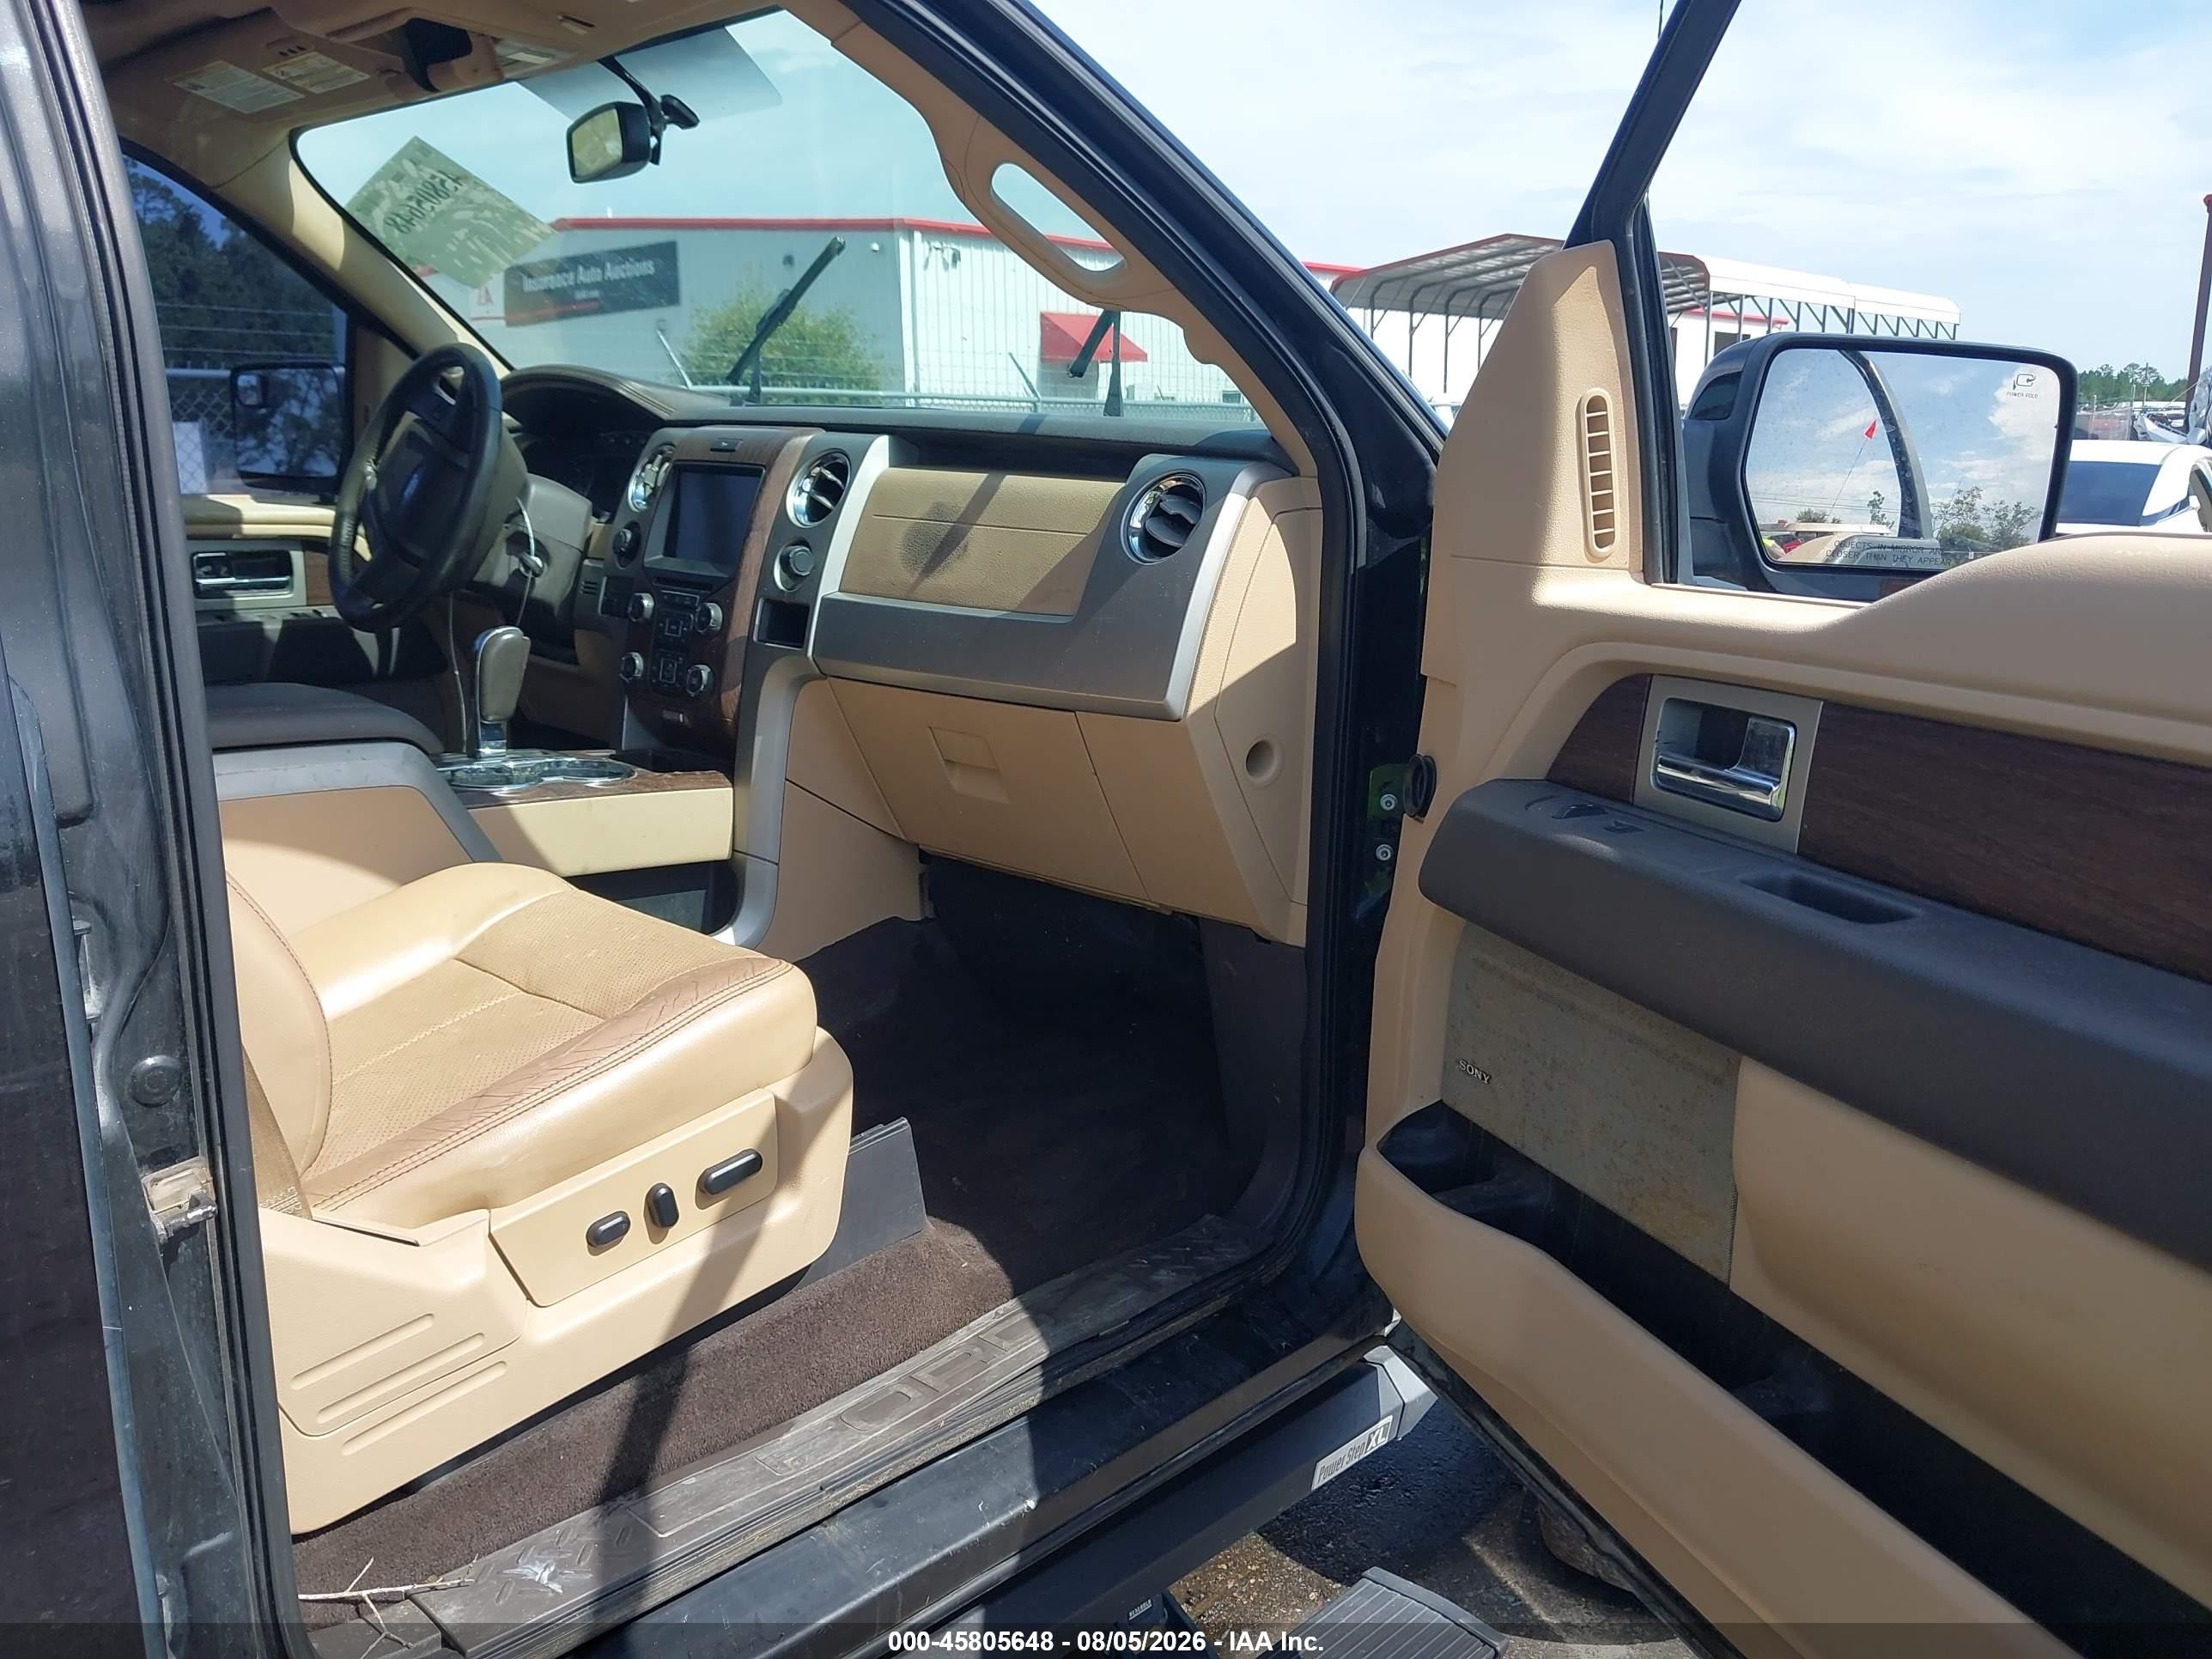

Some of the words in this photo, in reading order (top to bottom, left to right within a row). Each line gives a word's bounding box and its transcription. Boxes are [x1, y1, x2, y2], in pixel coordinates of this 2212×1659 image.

[522, 271, 575, 292] Insurance
[576, 264, 602, 284] Auto
[604, 259, 655, 281] Auctions
[1826, 550, 1860, 559] CLOSER
[1866, 552, 1887, 561] THAN
[1893, 554, 1914, 563] THEY
[1917, 556, 1952, 567] APPEAR
[1833, 540, 1872, 550] OBJECTS
[1891, 544, 1924, 554] MIRROR
[1459, 1059, 1492, 1085] SONY
[1317, 1454, 1346, 1484] Power
[1346, 1441, 1366, 1465] Step
[1366, 1425, 1387, 1452] XL
